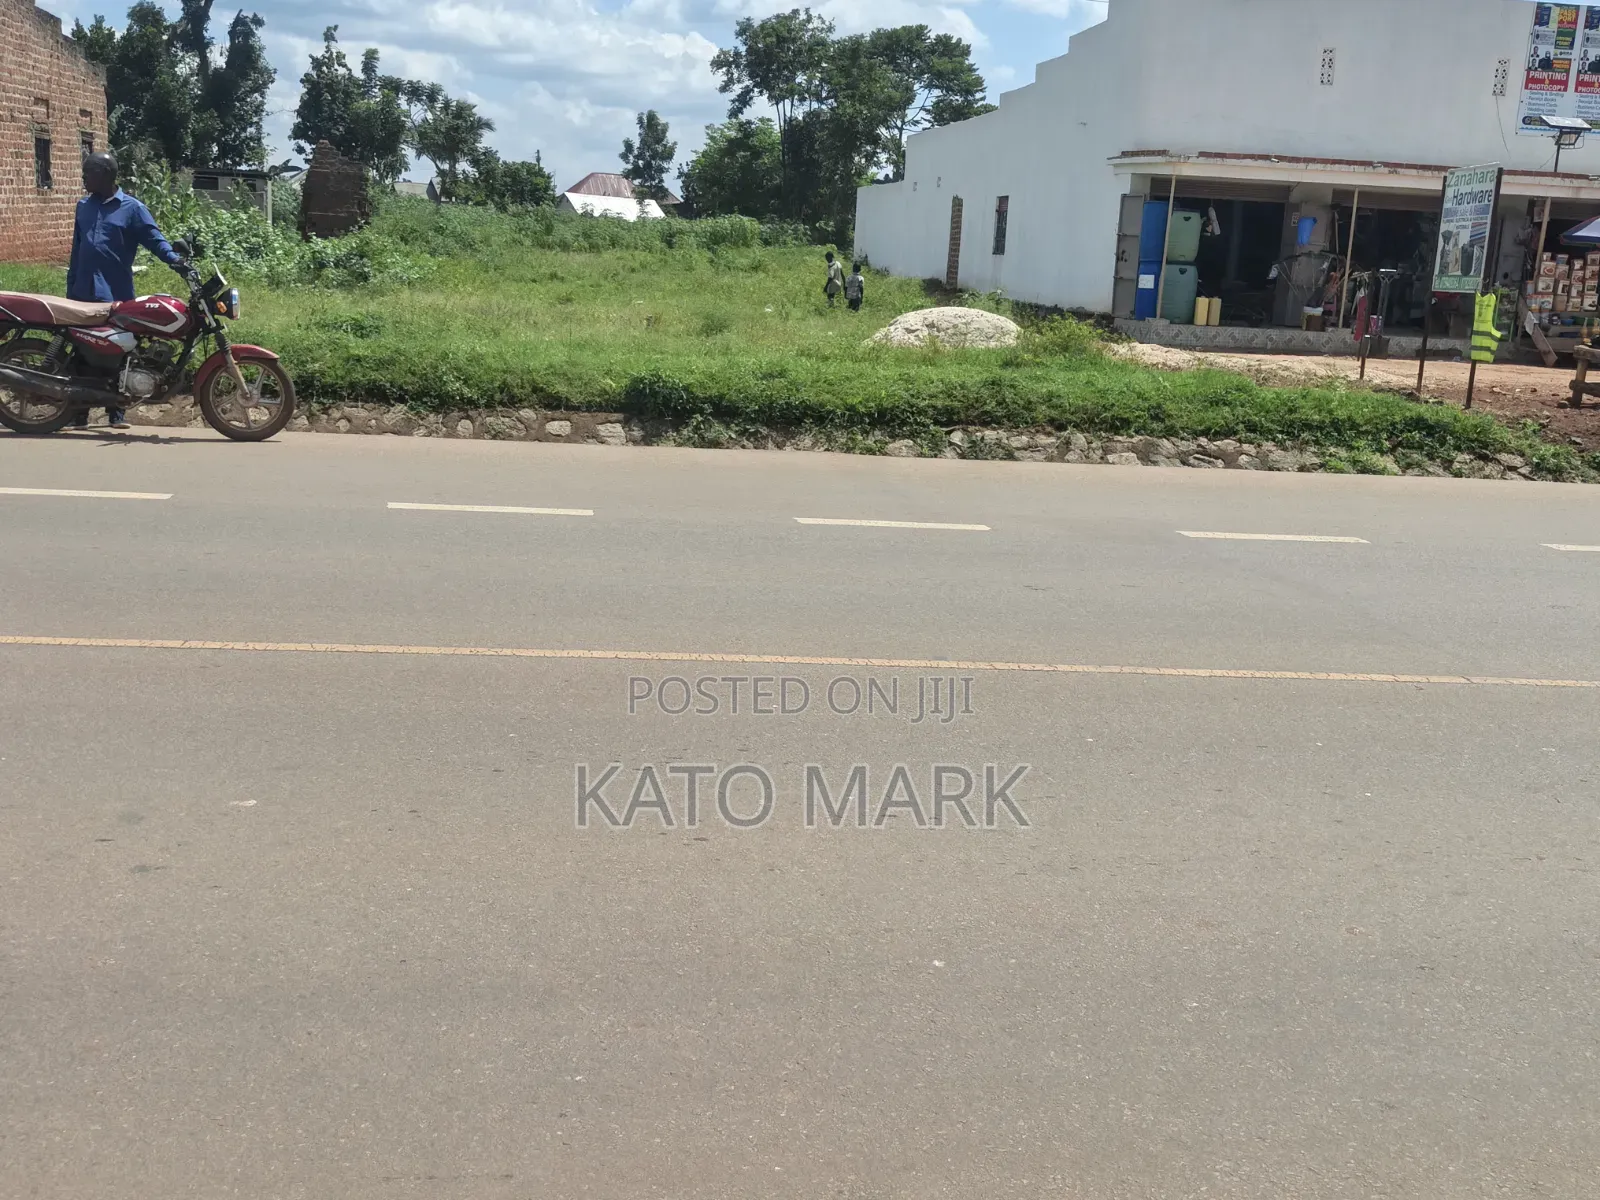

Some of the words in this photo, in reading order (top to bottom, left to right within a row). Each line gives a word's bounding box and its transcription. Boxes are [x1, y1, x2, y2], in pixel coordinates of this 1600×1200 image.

[1529, 70, 1567, 80] PRINTING
[1528, 83, 1565, 92] PHOTOCOPY
[1447, 168, 1496, 188] Zanahara
[1452, 187, 1493, 206] Hardware
